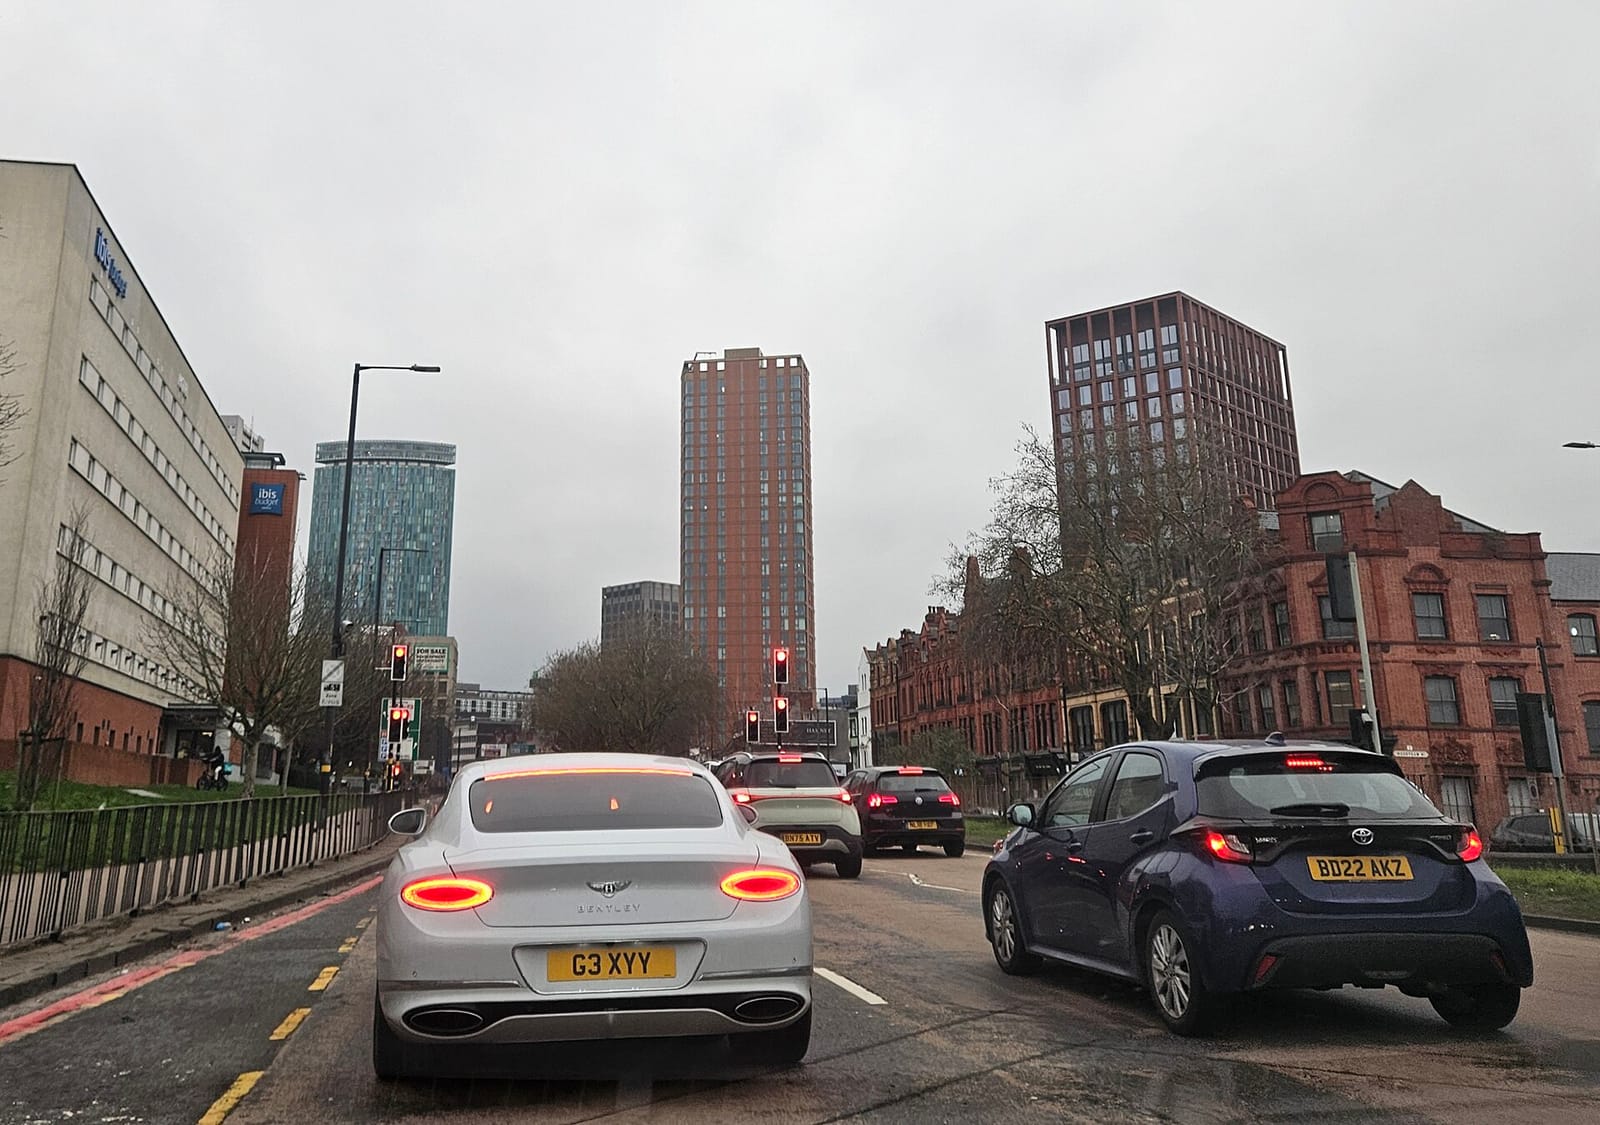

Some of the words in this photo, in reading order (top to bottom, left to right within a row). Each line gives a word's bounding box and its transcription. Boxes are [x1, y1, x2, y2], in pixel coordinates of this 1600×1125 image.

[95, 227, 109, 271] ibis
[258, 488, 277, 499] ibis
[254, 498, 279, 508] budget
[1317, 859, 1366, 877] BD22
[1371, 859, 1406, 877] AKZ
[577, 904, 641, 914] BENTLEY
[572, 953, 602, 976] G3
[608, 952, 651, 975] XYY
